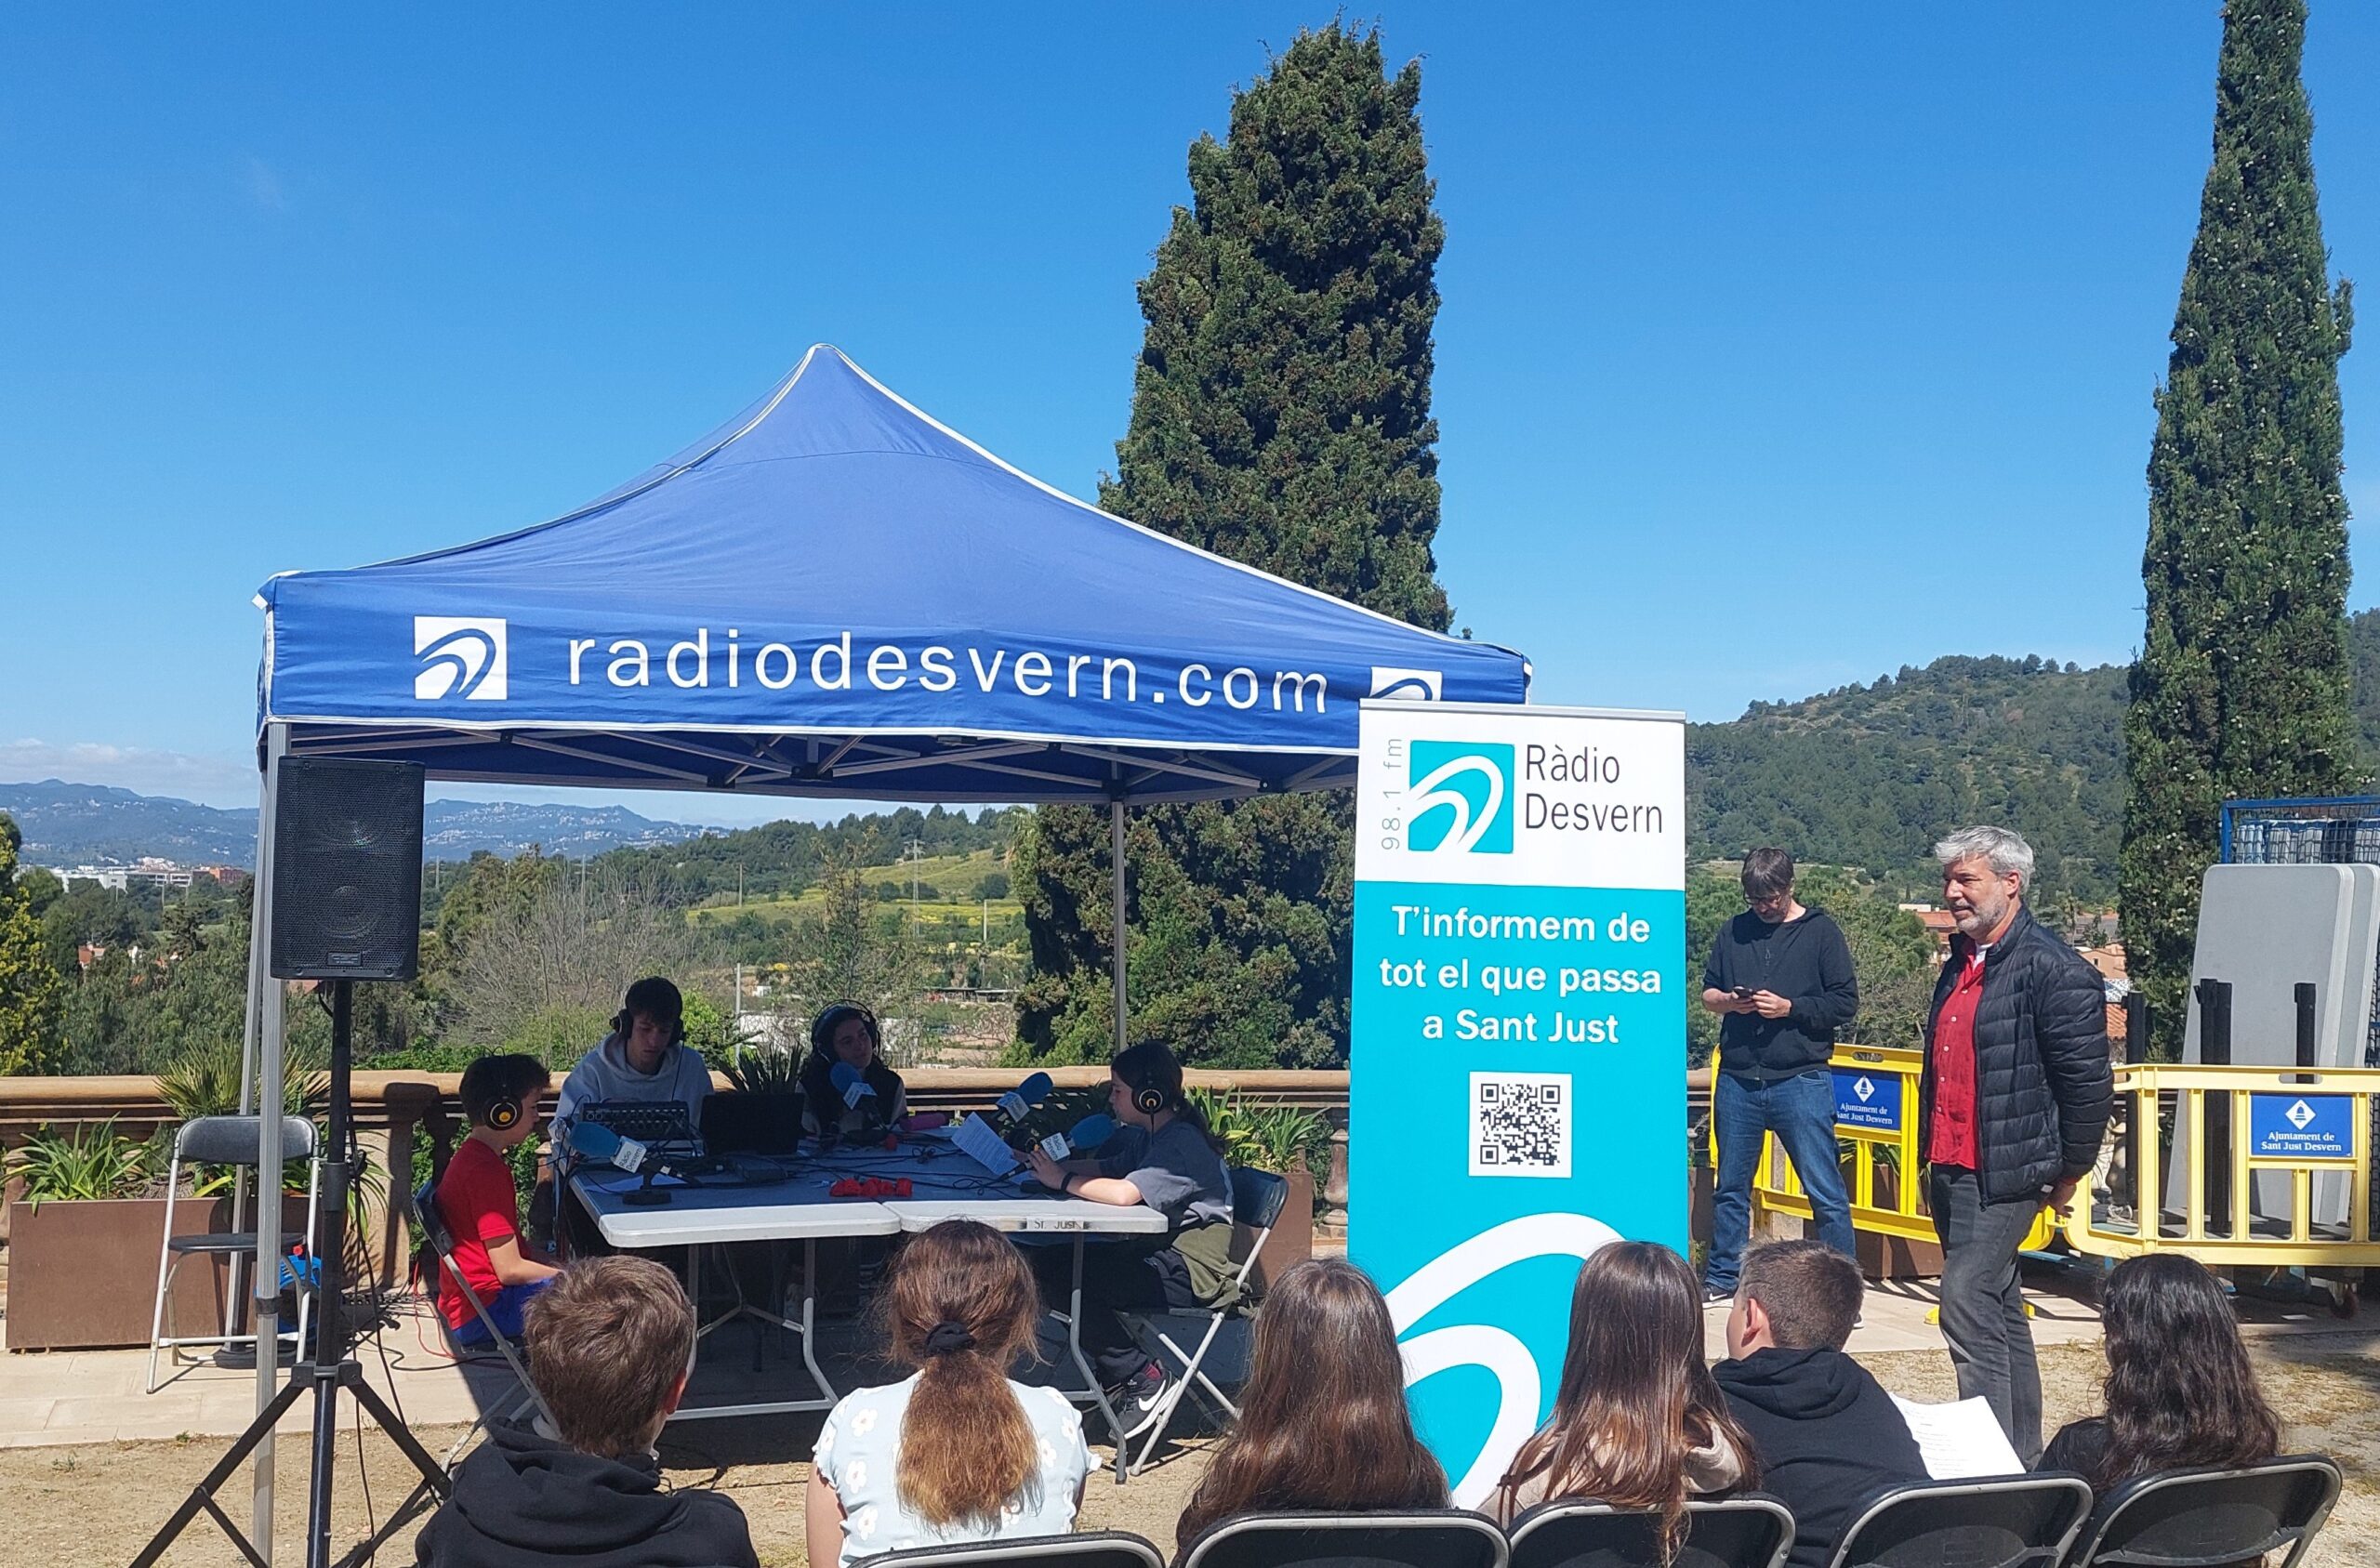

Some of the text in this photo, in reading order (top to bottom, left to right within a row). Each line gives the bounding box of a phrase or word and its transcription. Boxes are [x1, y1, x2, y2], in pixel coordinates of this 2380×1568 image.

[568, 627, 1328, 714] radiodesvern.com
[1526, 744, 1620, 784] Ràdio
[1382, 738, 1403, 850] 98.1 fm
[1526, 793, 1663, 834] Desvern
[1607, 912, 1651, 942] de
[1380, 958, 1661, 998] tot el que passa
[1422, 1008, 1620, 1044] a Sant Just
[1840, 1102, 1888, 1115] Ajuntament de
[1865, 1114, 1893, 1125] Desvern
[2261, 1141, 2342, 1152] Sant Just Desvern
[2268, 1131, 2335, 1141] Ajuntament de
